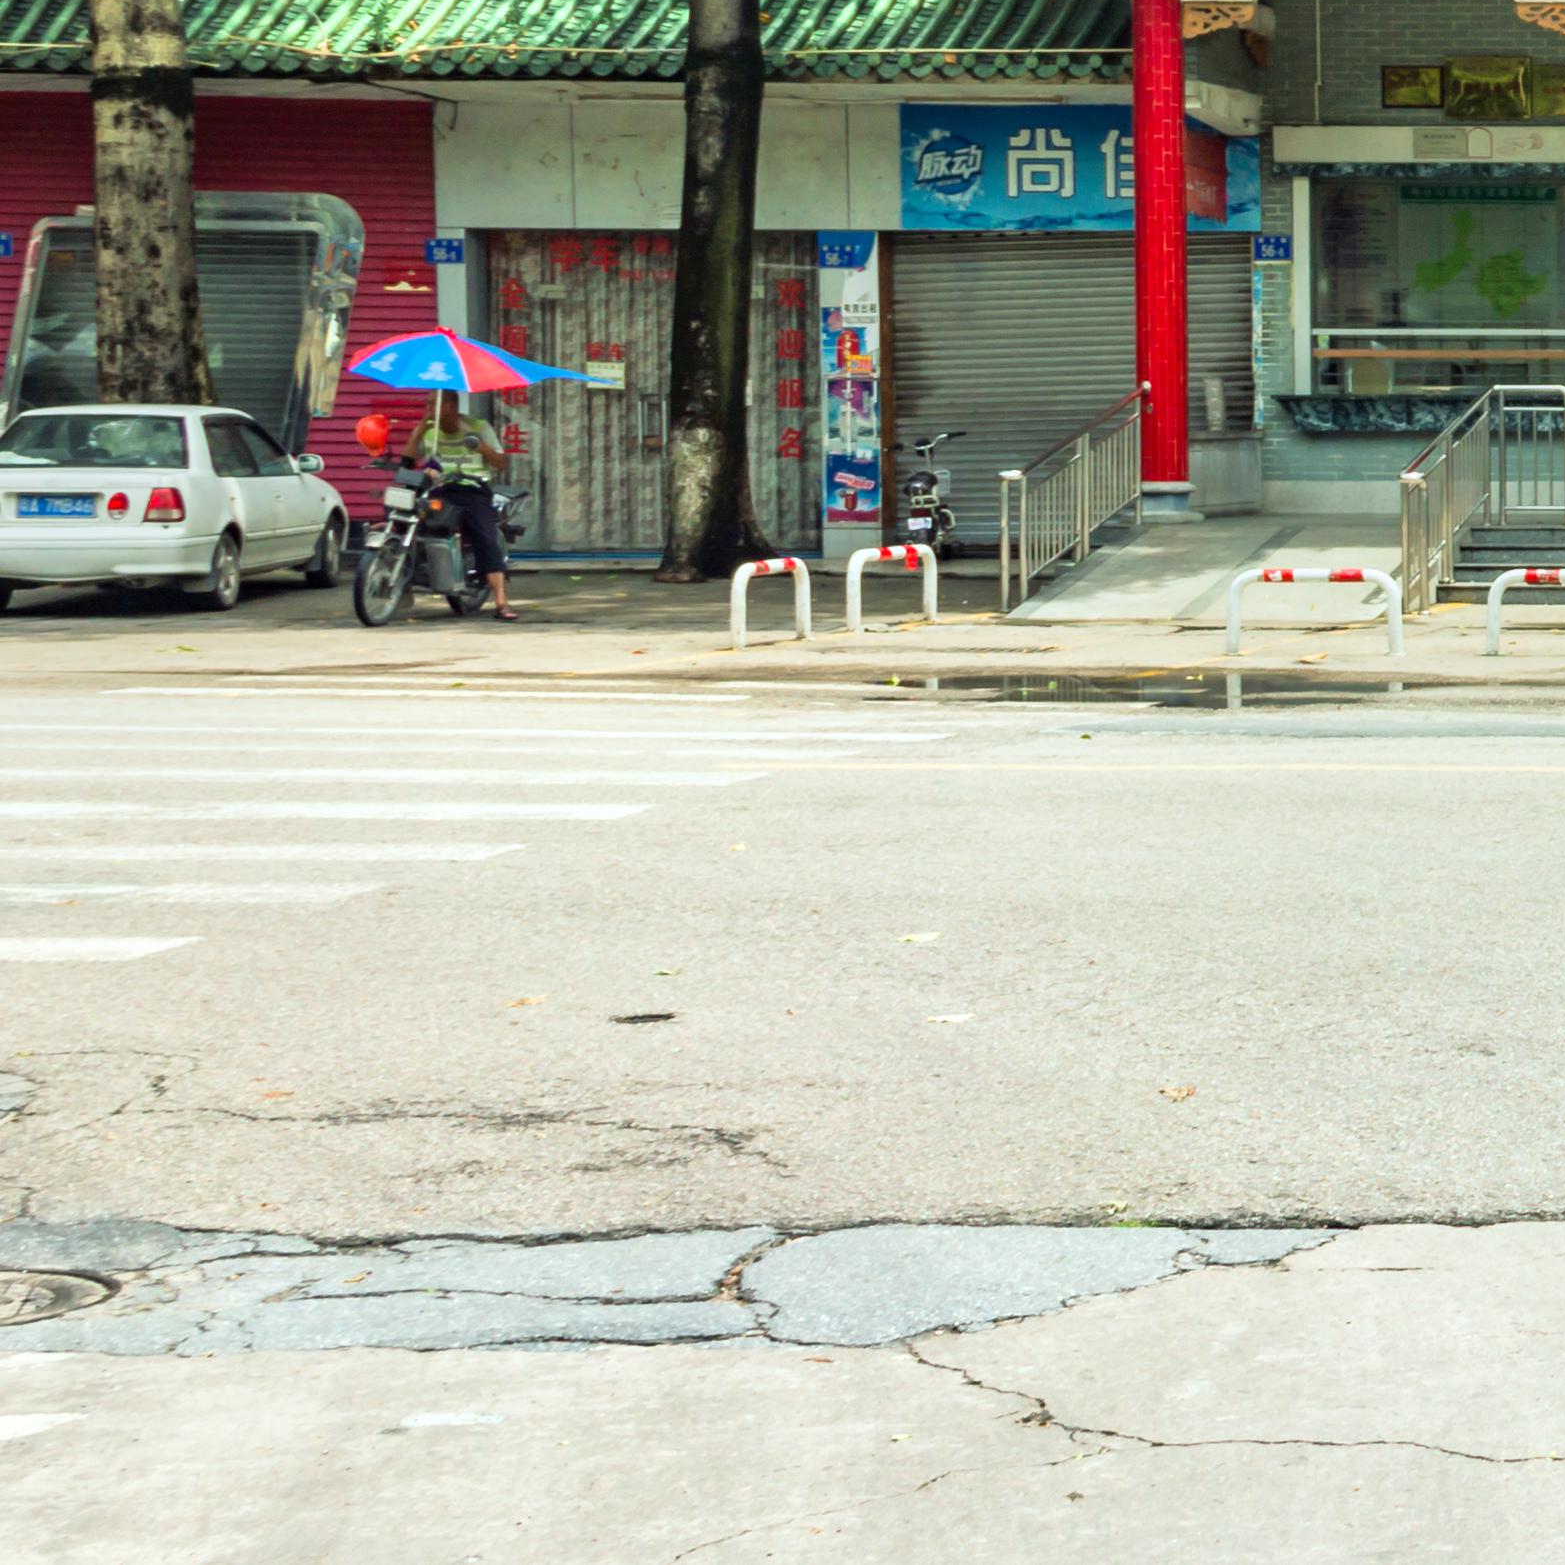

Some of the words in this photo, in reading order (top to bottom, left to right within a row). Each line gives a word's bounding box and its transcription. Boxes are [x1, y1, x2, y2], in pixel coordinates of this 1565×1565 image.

[919, 144, 983, 180] 脉动
[776, 277, 805, 460] 欢迎报名
